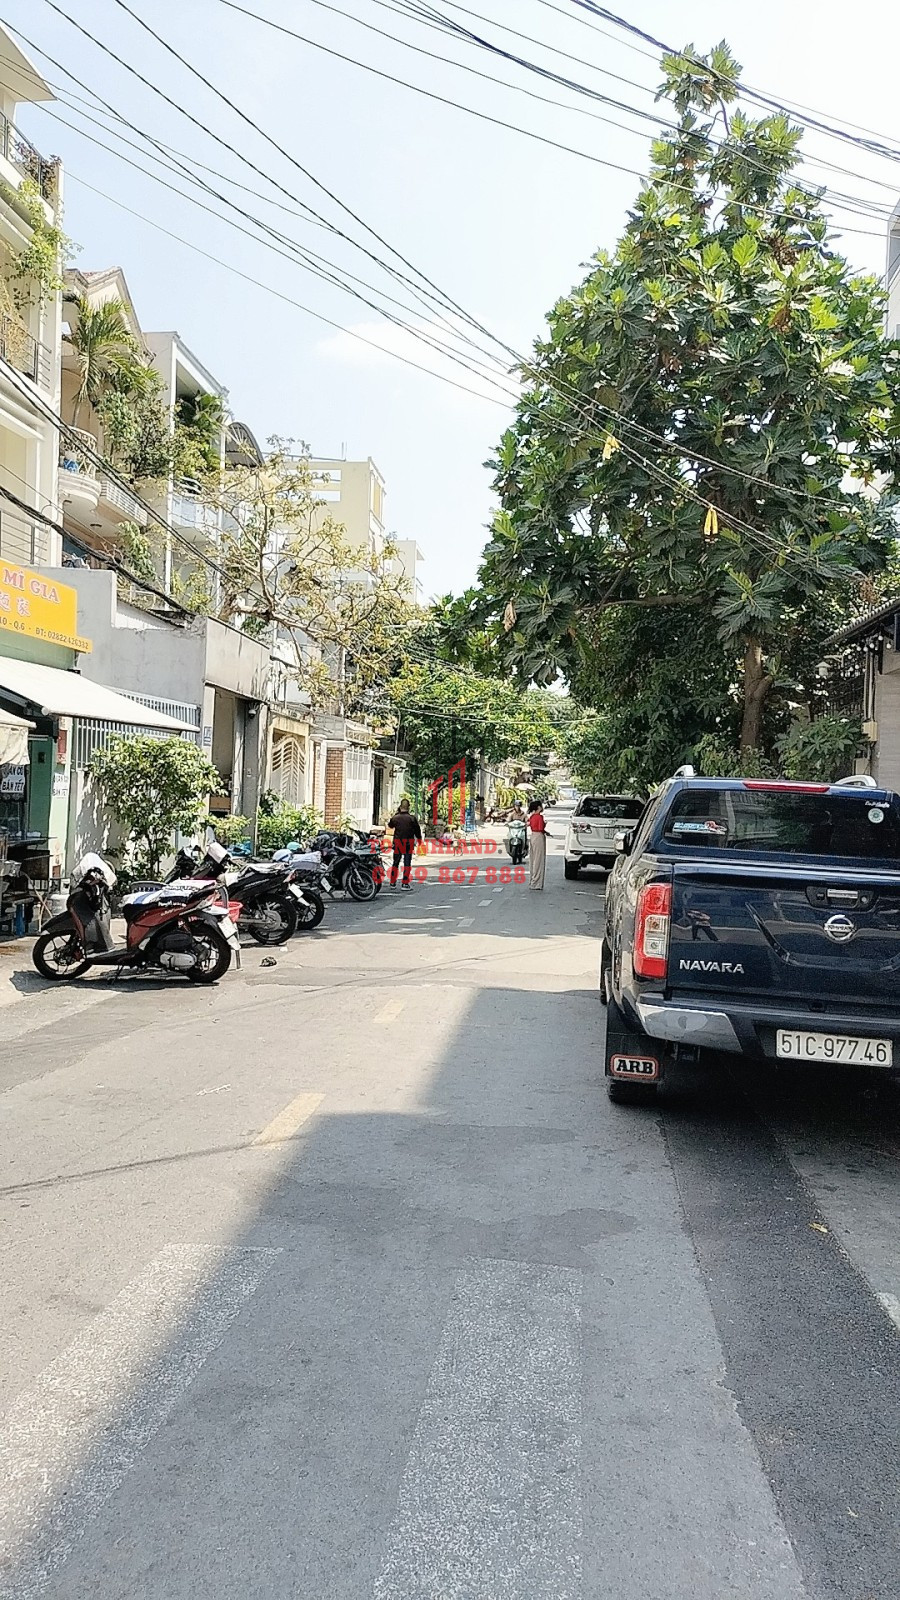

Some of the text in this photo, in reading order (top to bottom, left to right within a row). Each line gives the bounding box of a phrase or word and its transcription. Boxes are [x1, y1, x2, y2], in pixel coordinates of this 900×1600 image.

[30, 579, 60, 604] GIA
[13, 620, 25, 631] Q.6
[678, 958, 746, 975] NAVARA
[780, 1033, 888, 1064] 51C-977.46
[616, 1059, 654, 1076] ARB
